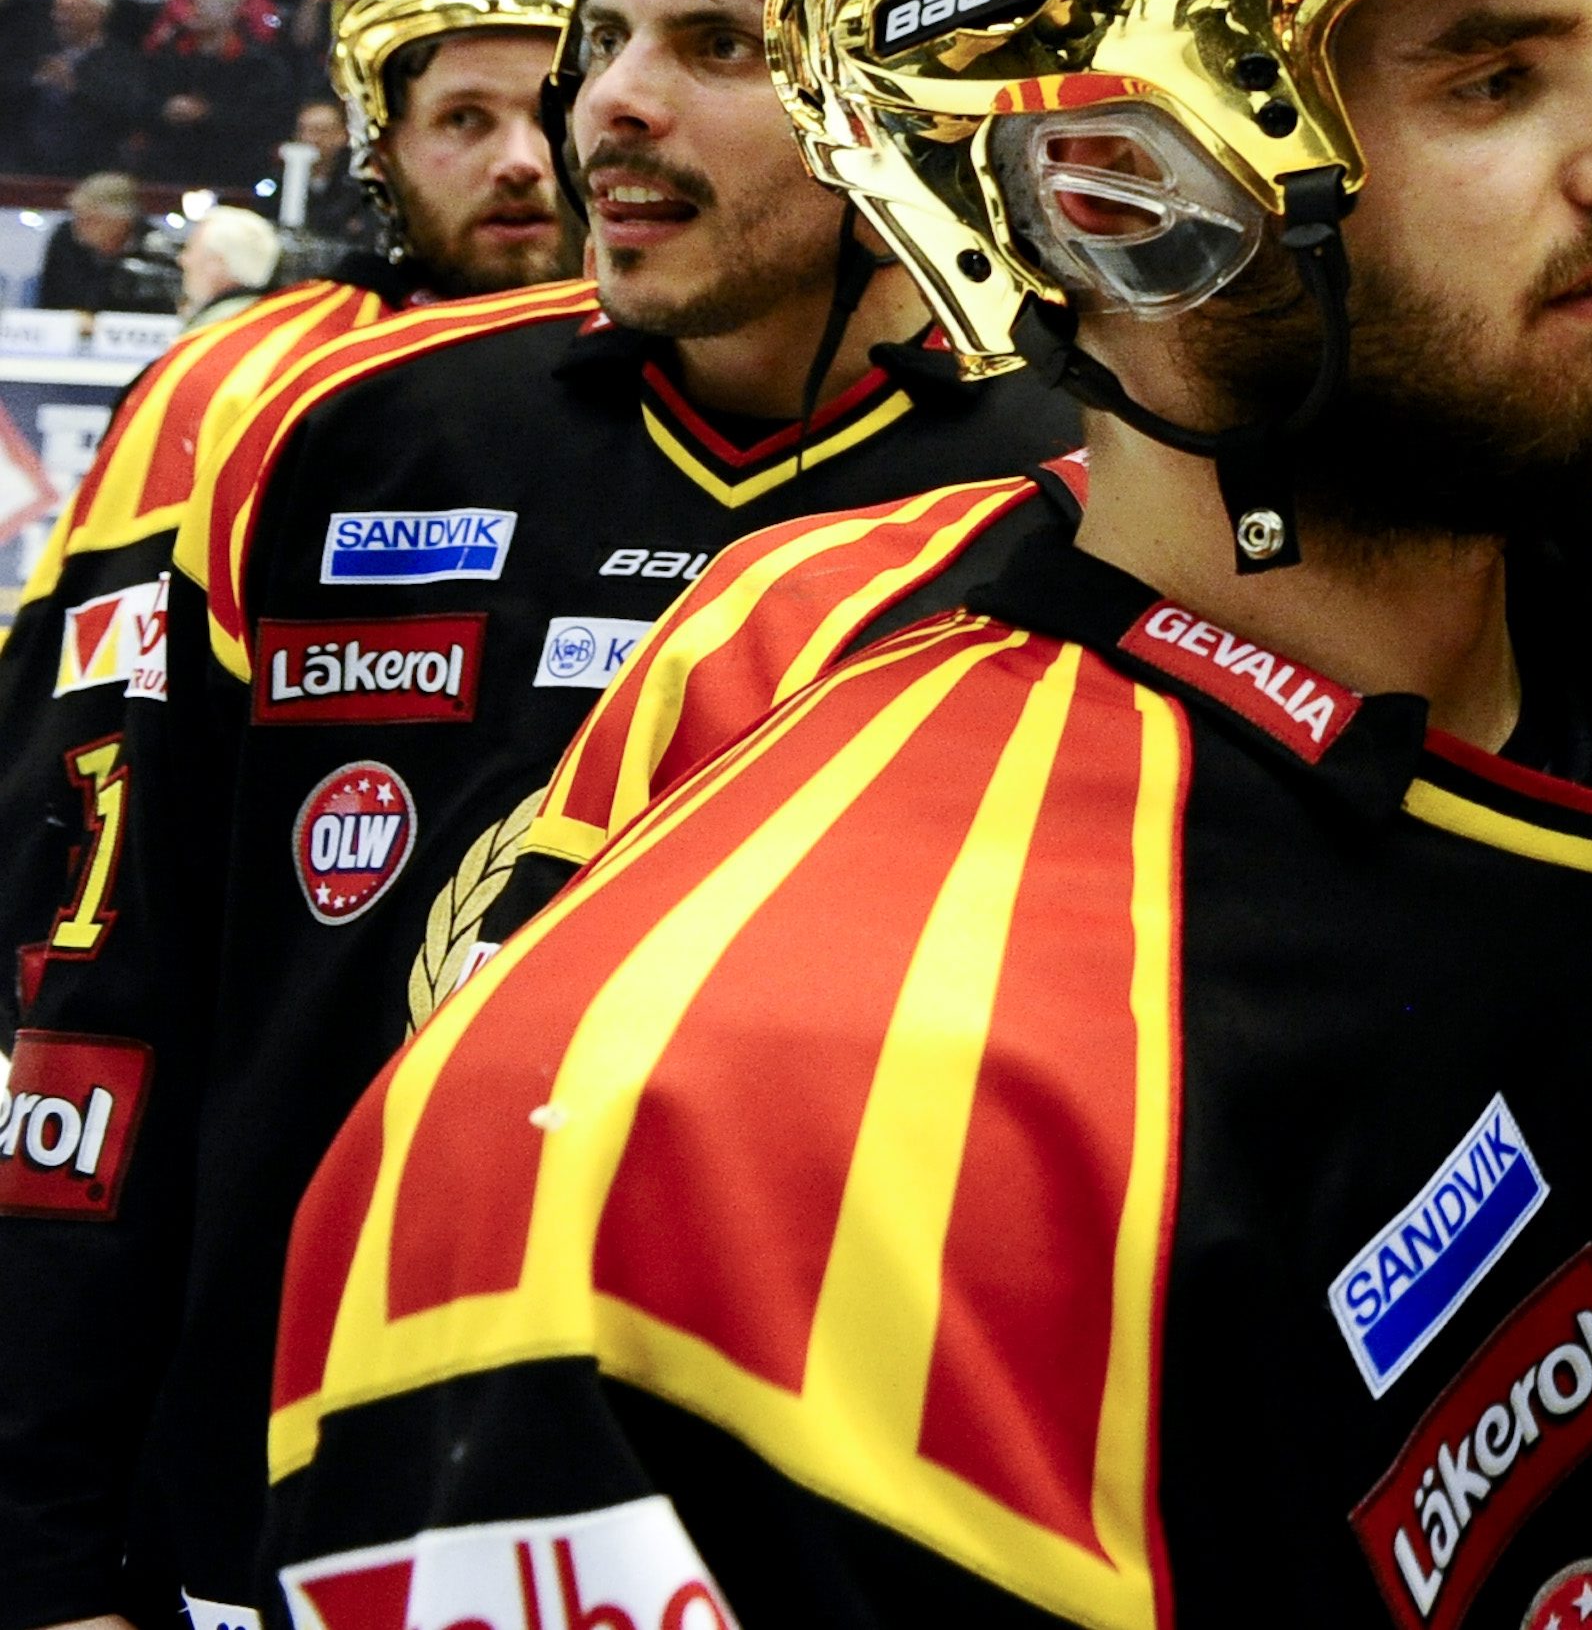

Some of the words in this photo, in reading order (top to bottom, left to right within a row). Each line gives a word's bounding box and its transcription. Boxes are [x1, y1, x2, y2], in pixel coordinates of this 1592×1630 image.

[335, 516, 503, 552] SANDVIK
[271, 640, 465, 703] Läkerol
[1144, 606, 1336, 743] GEVALIA
[310, 813, 401, 873] OLW
[1345, 1114, 1519, 1329] SANDVIK
